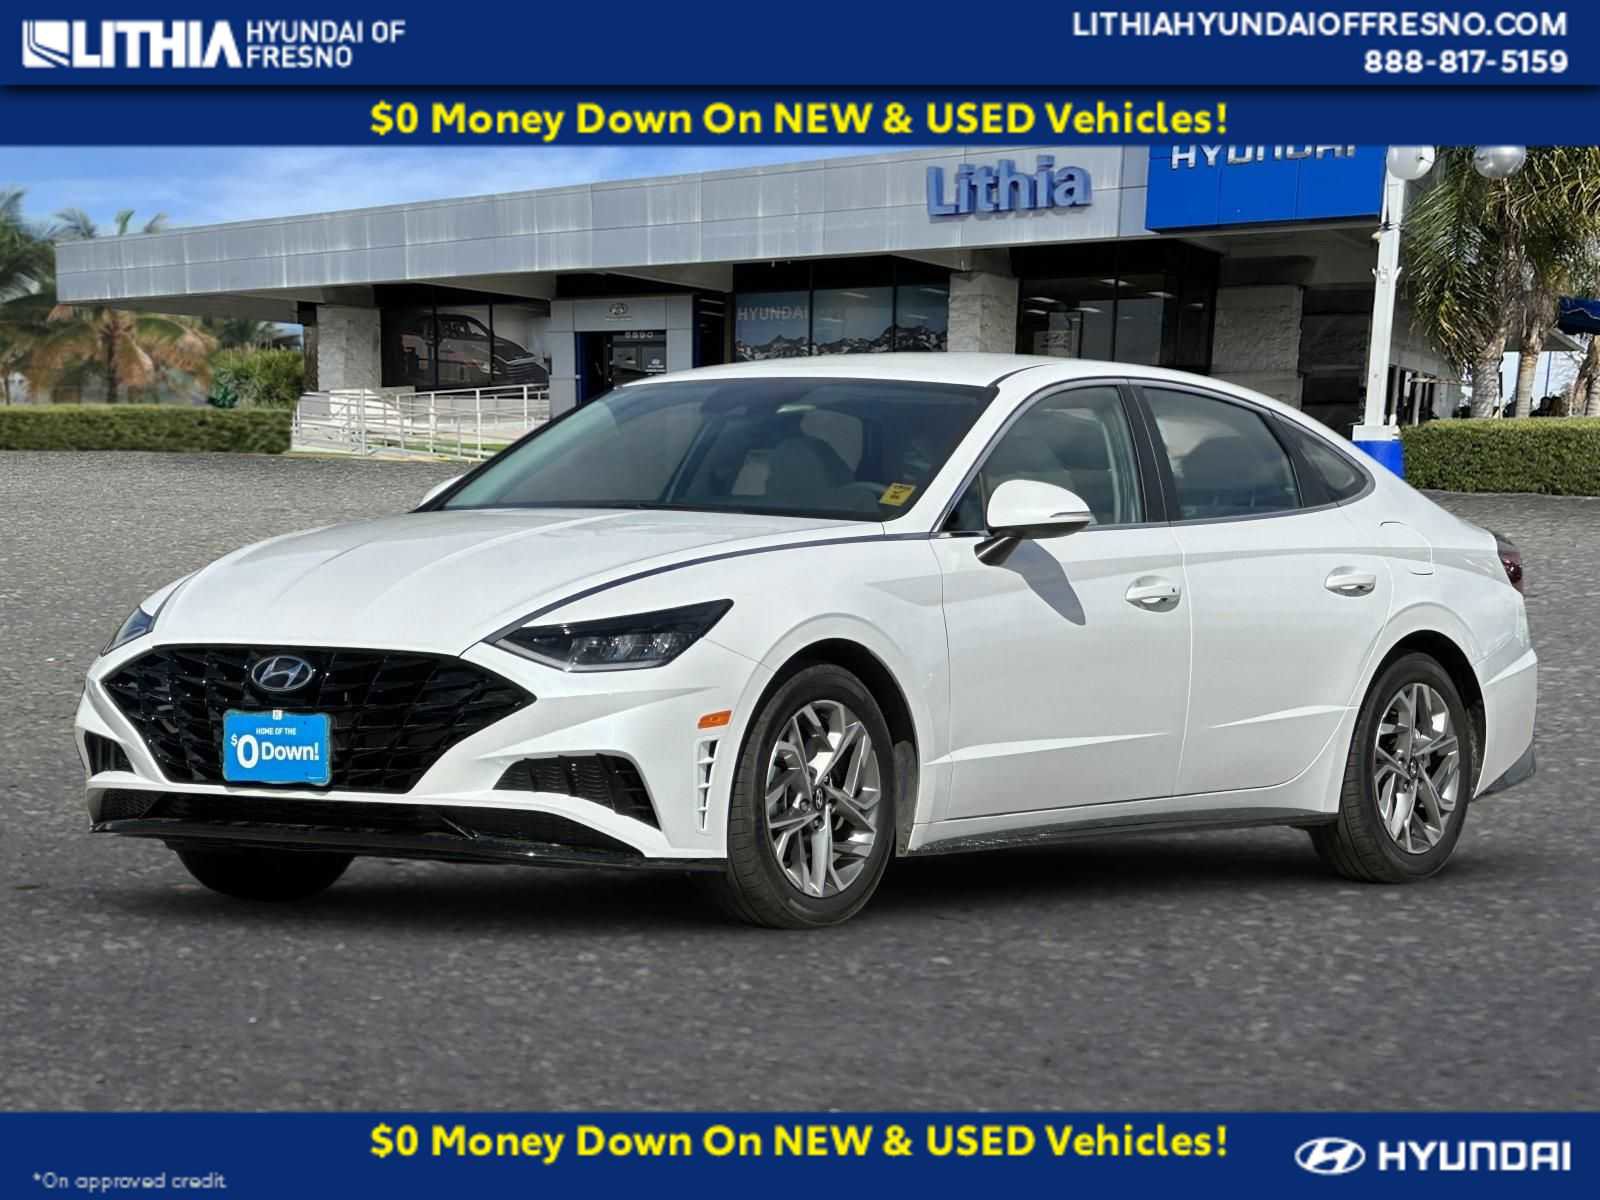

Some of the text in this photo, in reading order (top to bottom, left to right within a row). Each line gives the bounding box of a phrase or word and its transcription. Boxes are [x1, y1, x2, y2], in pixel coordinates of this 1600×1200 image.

[927, 154, 1092, 216] Lithia
[737, 305, 808, 320] HYUNDAI
[230, 734, 320, 769] $0 Down!
